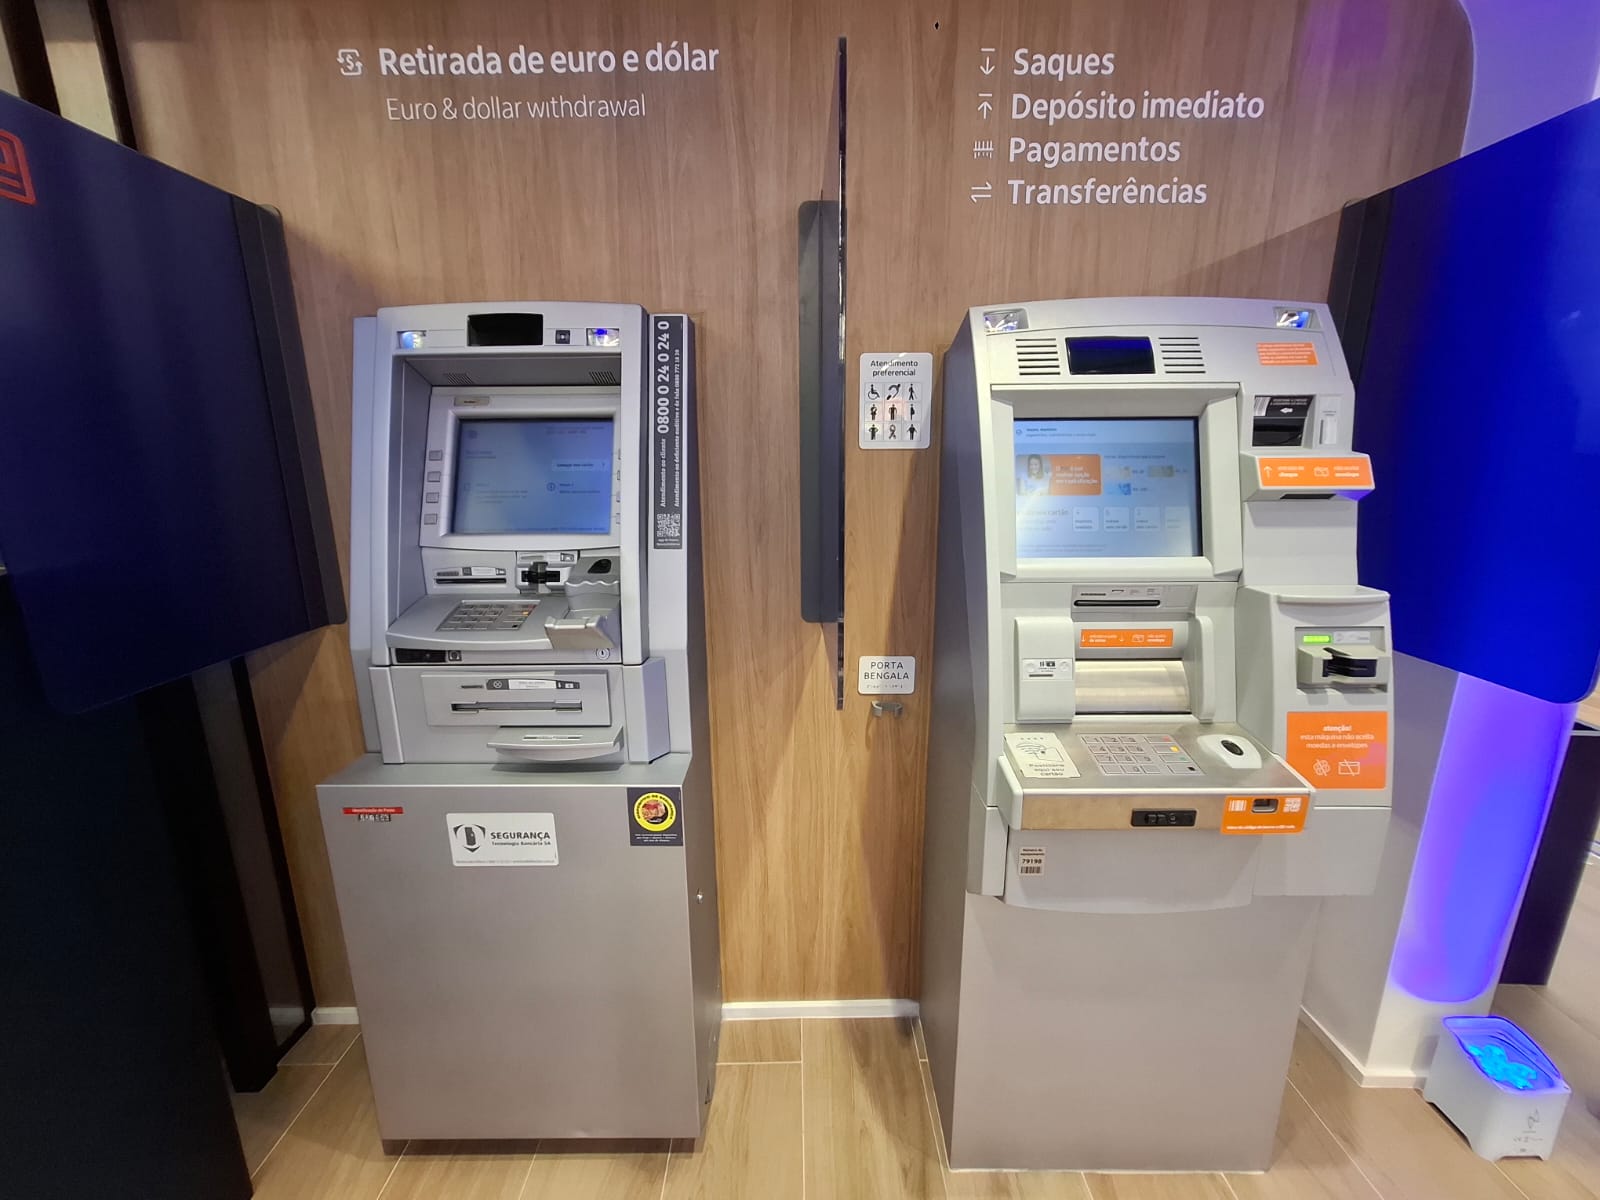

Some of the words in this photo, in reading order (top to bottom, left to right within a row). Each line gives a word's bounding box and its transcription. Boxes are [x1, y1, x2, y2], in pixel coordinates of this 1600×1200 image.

[378, 44, 502, 76] Retirada
[508, 44, 544, 74] de
[550, 49, 616, 74] euro
[622, 49, 639, 73] e
[645, 40, 719, 73] dólar
[1013, 47, 1115, 82] Saques
[386, 97, 437, 121] Euro
[442, 97, 458, 120] &
[462, 95, 521, 120] dollar
[528, 93, 645, 119] withdrawal
[1011, 89, 1136, 126] Depósito
[1142, 90, 1265, 119] imediato
[1008, 136, 1181, 169] Pagamentos
[1007, 176, 1207, 205] Transferências
[657, 321, 670, 330] 0
[657, 333, 670, 351] 24
[657, 353, 670, 362] 0
[657, 365, 670, 383] 24
[872, 369, 916, 377] preferencial
[657, 385, 670, 395] 0
[657, 397, 670, 434] 0800
[870, 661, 904, 670] PORTA
[864, 672, 909, 680] BENGALA
[490, 831, 551, 841] SEGURANÇA
